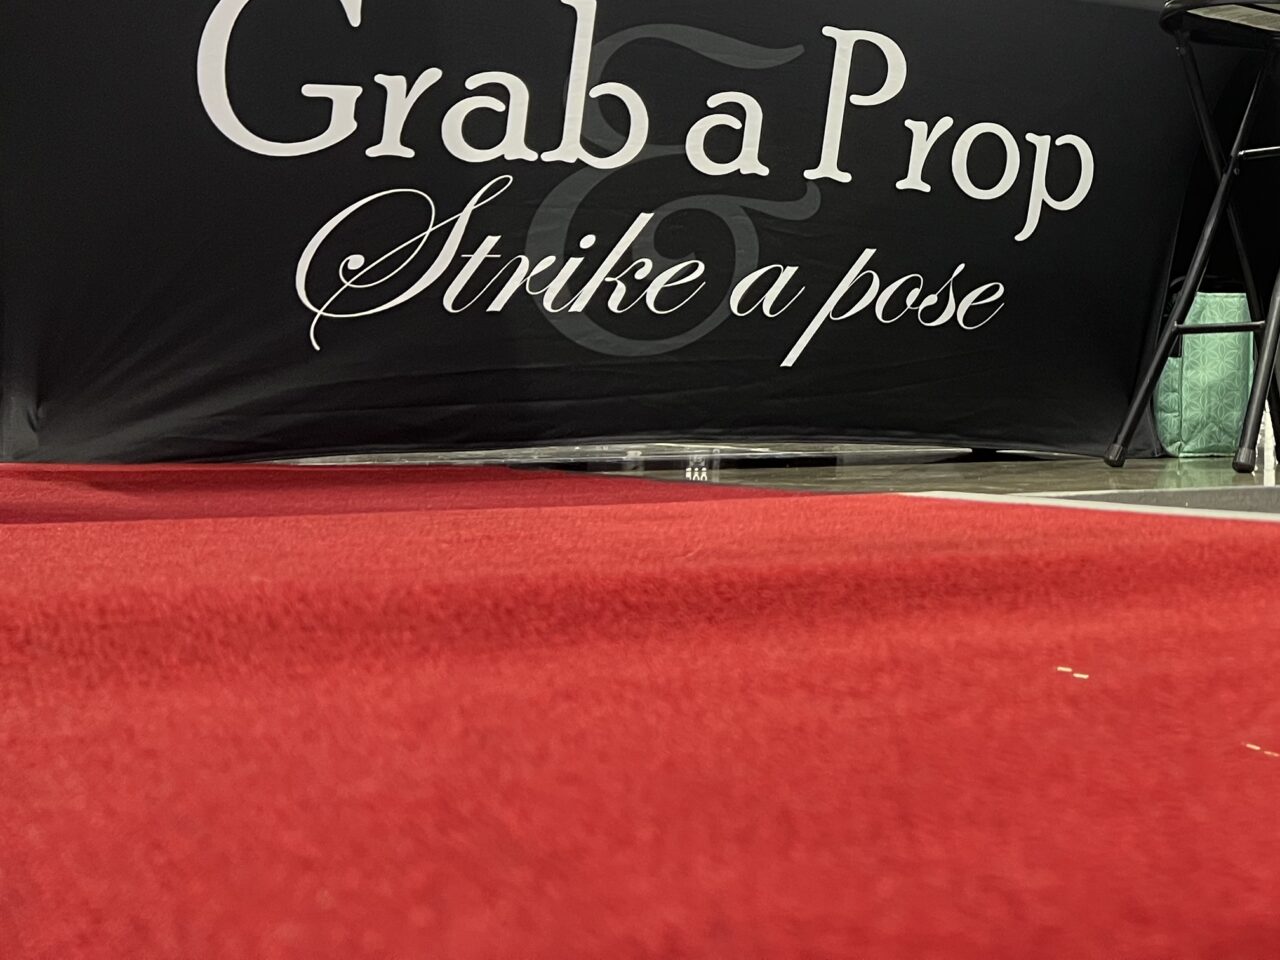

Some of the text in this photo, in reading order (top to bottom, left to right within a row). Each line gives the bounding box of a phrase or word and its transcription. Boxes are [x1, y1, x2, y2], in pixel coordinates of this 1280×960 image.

[685, 90, 770, 177] a
[803, 25, 1095, 242] Prop
[294, 174, 1006, 368] Strike a pose
